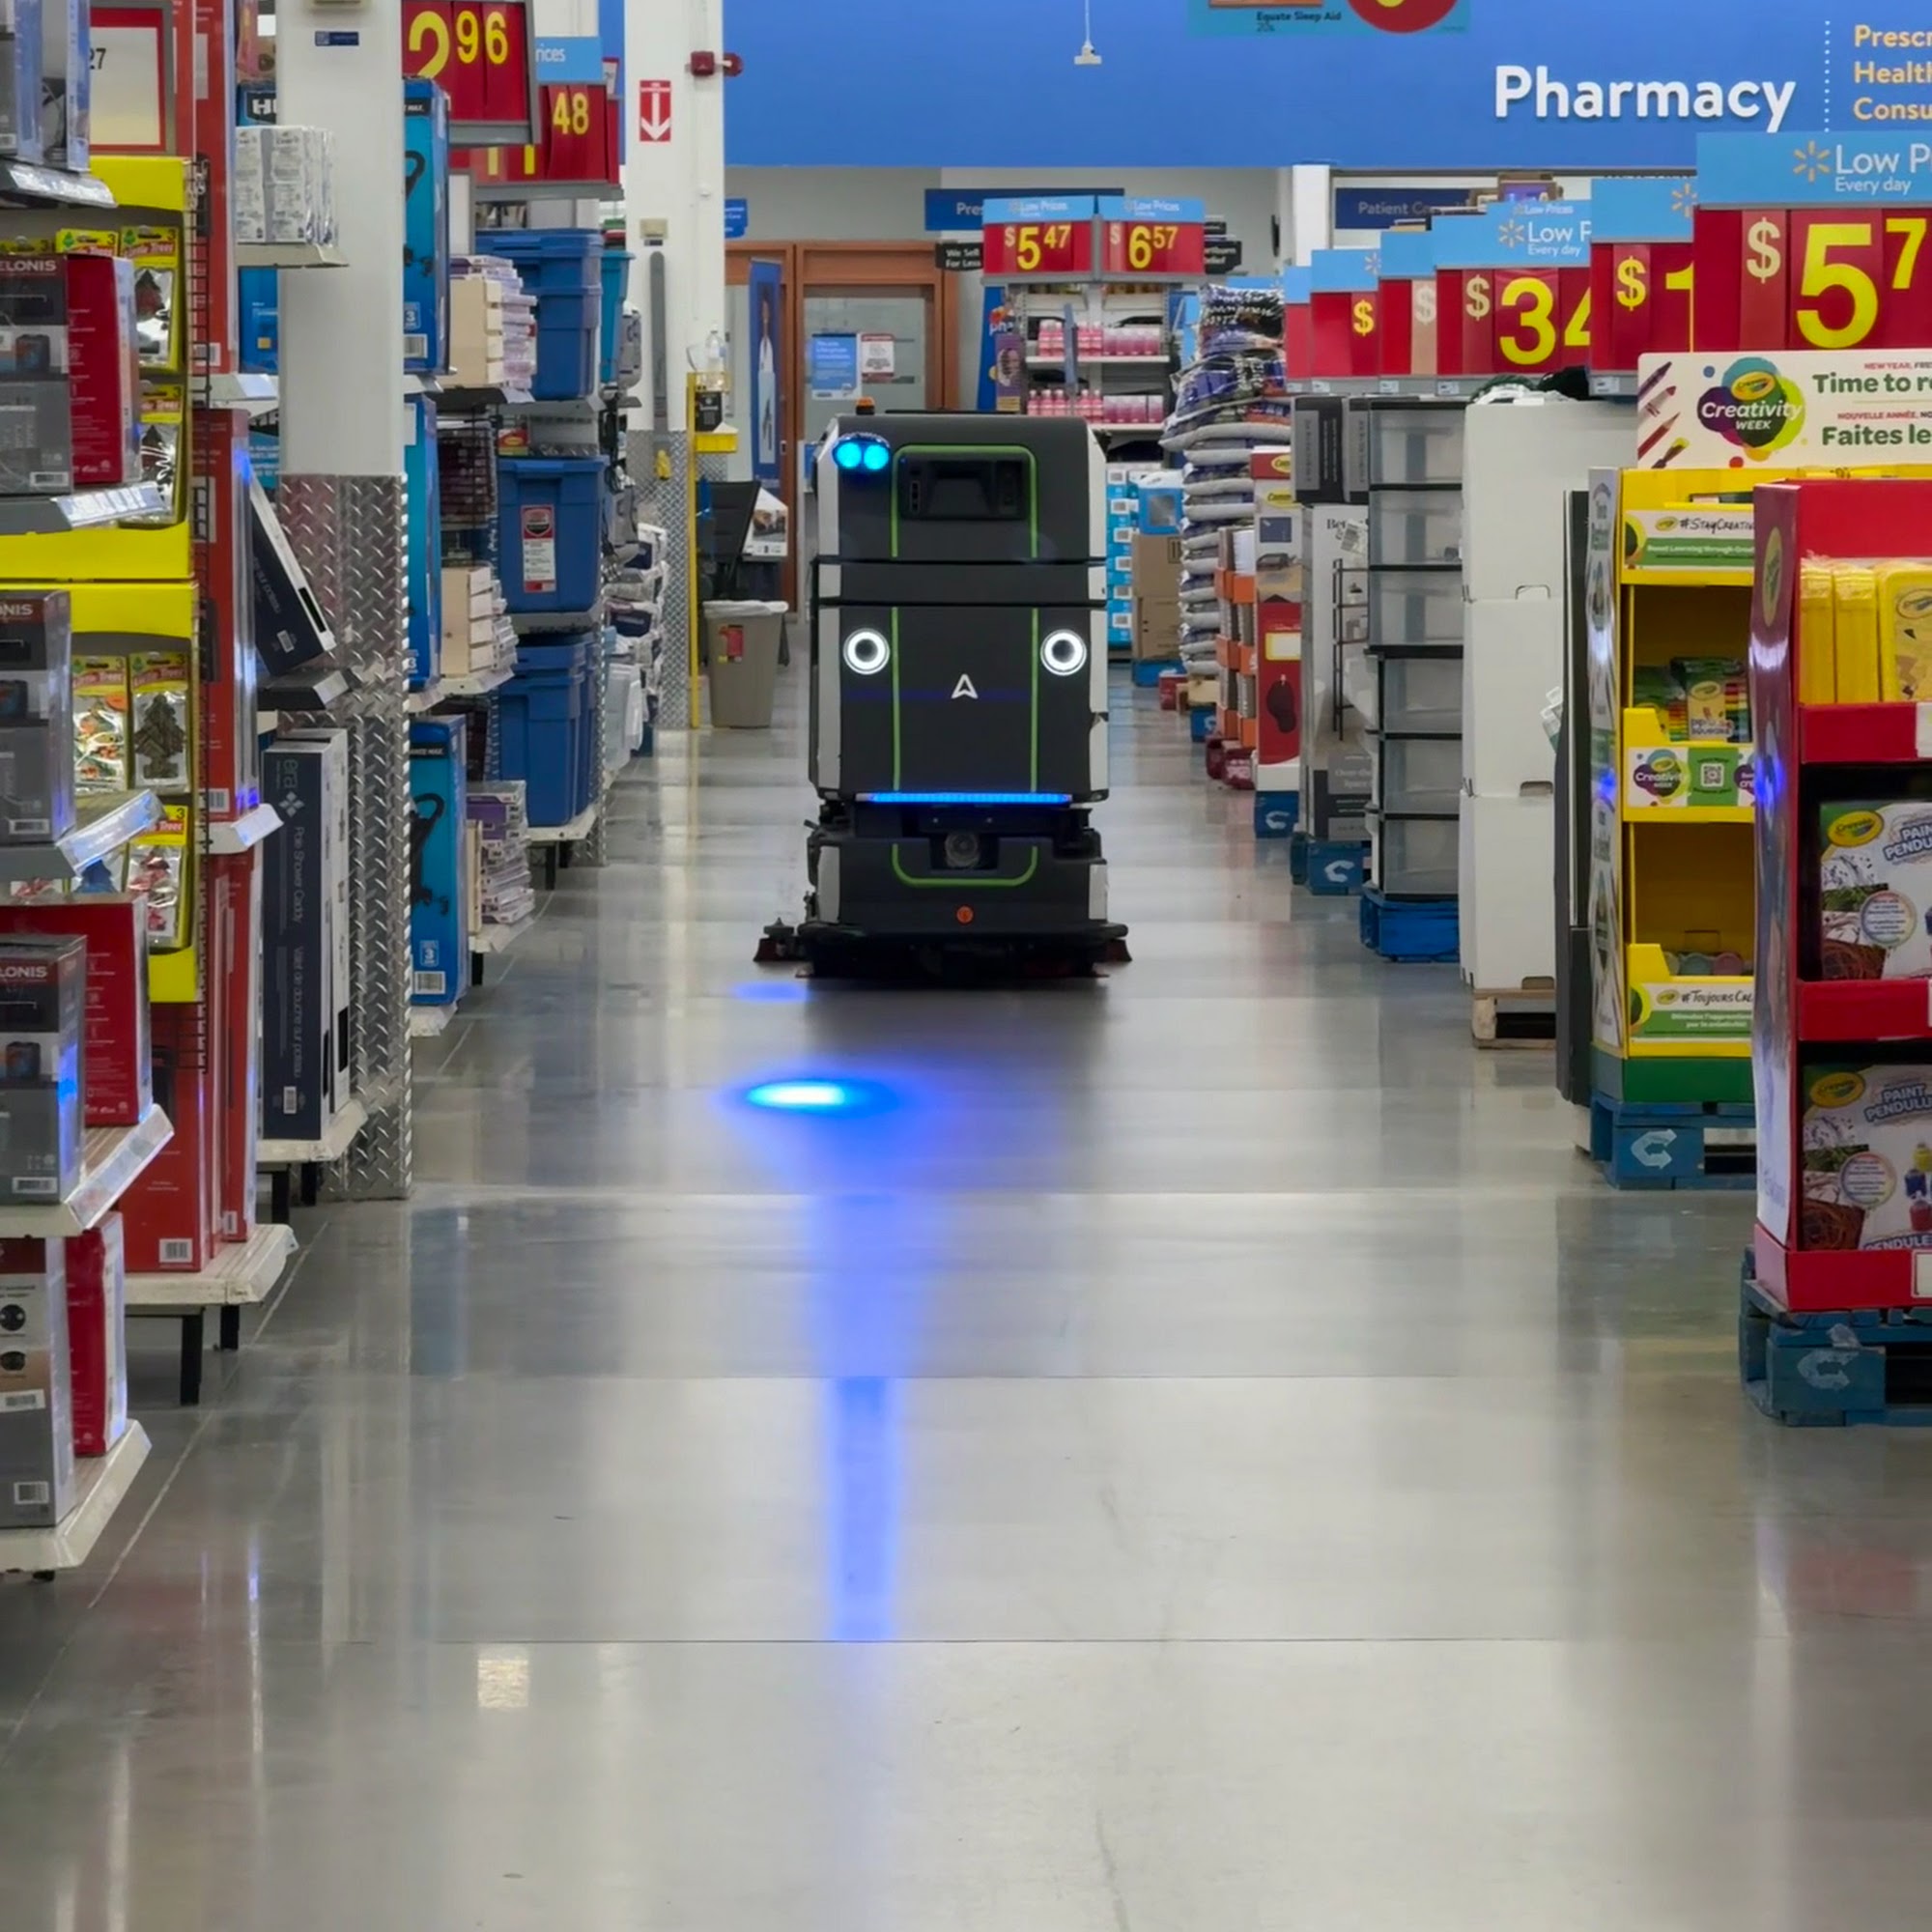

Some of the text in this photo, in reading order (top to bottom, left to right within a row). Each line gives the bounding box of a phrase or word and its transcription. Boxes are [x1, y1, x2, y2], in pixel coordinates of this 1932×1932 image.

[1257, 12, 1342, 22] Equate Sleep Aid
[252, 99, 276, 115] H
[1495, 65, 1797, 133] Pharmacy
[553, 92, 589, 135] 48
[1836, 144, 1932, 174] Low P
[1835, 177, 1912, 196] Every day
[1358, 201, 1408, 215] Patient
[1528, 221, 1574, 243] Low
[1528, 243, 1581, 258] Every day
[1353, 299, 1376, 336] $
[1812, 372, 1932, 394] Time to r
[1701, 400, 1804, 421] Creativity
[1837, 412, 1885, 420] NOUVELLE
[1736, 419, 1772, 431] WEEK
[1823, 423, 1932, 446] Faites le
[1884, 1085, 1926, 1104] PAINT
